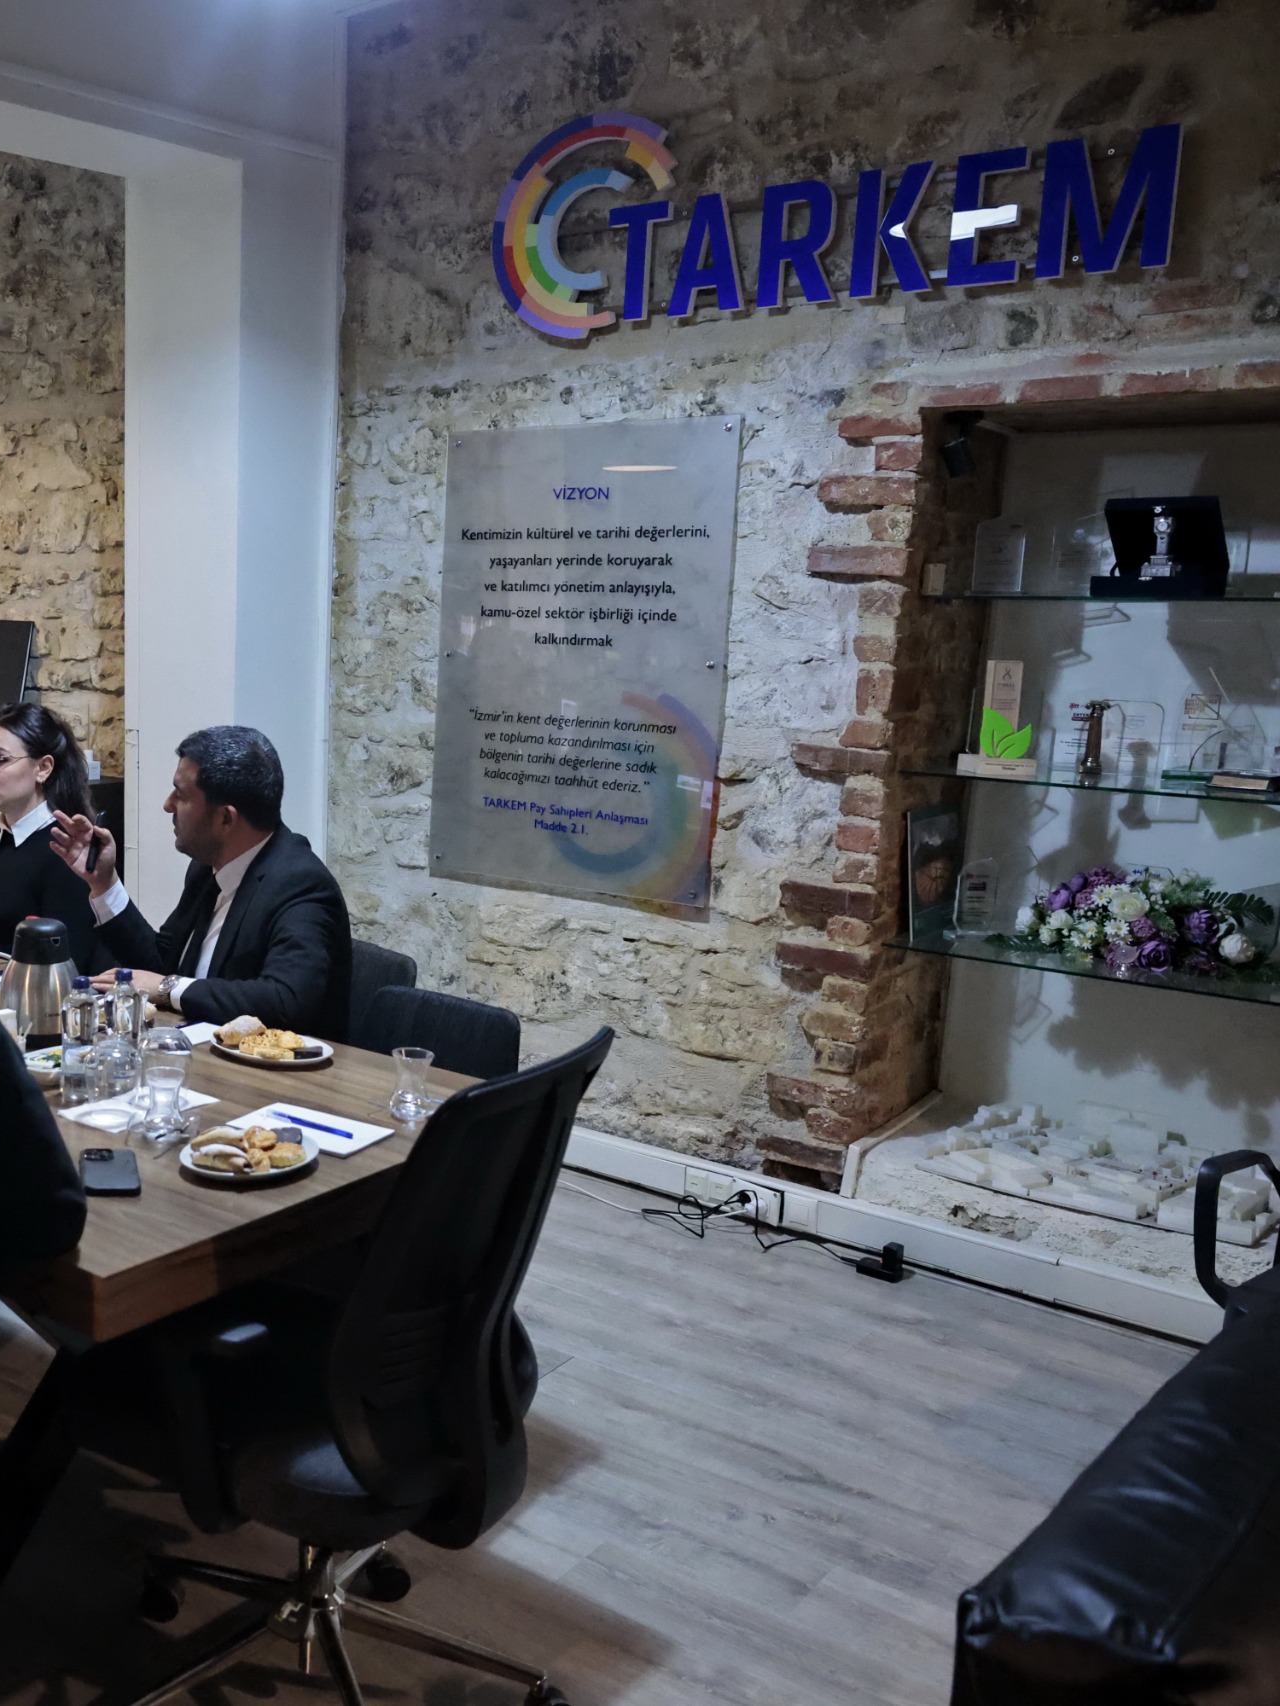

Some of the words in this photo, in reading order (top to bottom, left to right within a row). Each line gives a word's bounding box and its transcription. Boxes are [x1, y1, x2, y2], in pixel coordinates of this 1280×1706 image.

[608, 121, 1184, 321] TARKEM
[552, 484, 610, 500] VİZYON
[461, 528, 523, 541] Kentimizin
[526, 527, 573, 540] kültürel
[578, 530, 592, 539] ve
[596, 526, 630, 539] tarihi
[634, 525, 710, 542] değerlerini,
[489, 553, 552, 570] yaşayanları
[555, 553, 603, 570] yerinde
[606, 553, 673, 570] koruyarak
[484, 582, 497, 592] ve
[501, 580, 550, 593] katılımcı
[554, 580, 605, 597] yönetim
[608, 580, 676, 597] anlayışıyla,
[480, 605, 541, 619] kamu-özel
[544, 606, 585, 620] sektör
[589, 606, 634, 624] işbirliği
[637, 608, 677, 625] içinde
[534, 632, 613, 648] kalkındırmak
[517, 711, 541, 726] kent
[544, 714, 610, 731] değerlerinin
[614, 718, 677, 735] korunması
[484, 731, 496, 741] ve
[499, 731, 544, 745] topluma
[548, 734, 631, 752] kazandırılması
[634, 739, 655, 755] için
[479, 748, 523, 764] bölgenin
[527, 753, 556, 765] tarihi
[559, 755, 622, 772] değerlerine
[625, 761, 657, 774] sadık
[484, 767, 551, 786] kalacağımızı
[554, 774, 598, 789] taahhüt
[483, 796, 527, 811] TARKEM
[530, 802, 547, 816] Pay
[595, 809, 649, 826] Anlaşması
[534, 819, 568, 833] Madde
